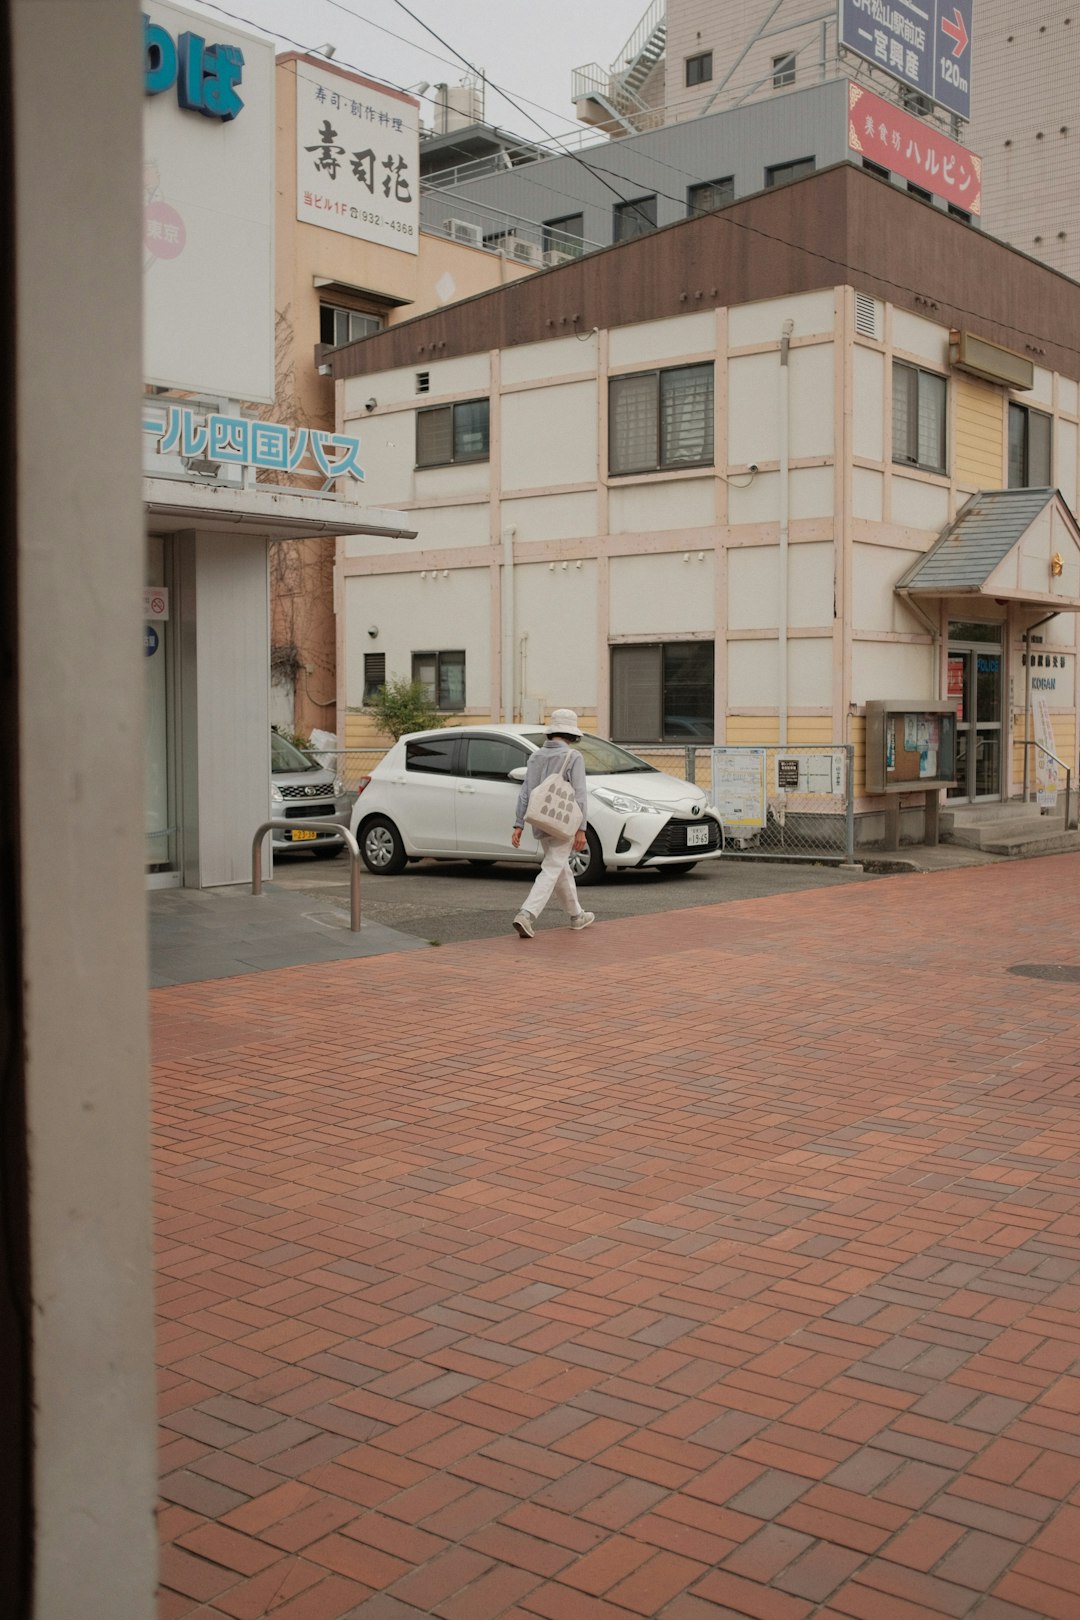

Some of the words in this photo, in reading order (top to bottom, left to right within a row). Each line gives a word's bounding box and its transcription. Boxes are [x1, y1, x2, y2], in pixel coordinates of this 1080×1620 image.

[858, 28, 919, 81] 一宮興産
[941, 56, 968, 93] 120m
[303, 190, 347, 217] 当ビル1F
[977, 657, 999, 672] POLICE
[1031, 677, 1056, 690] KOBAN
